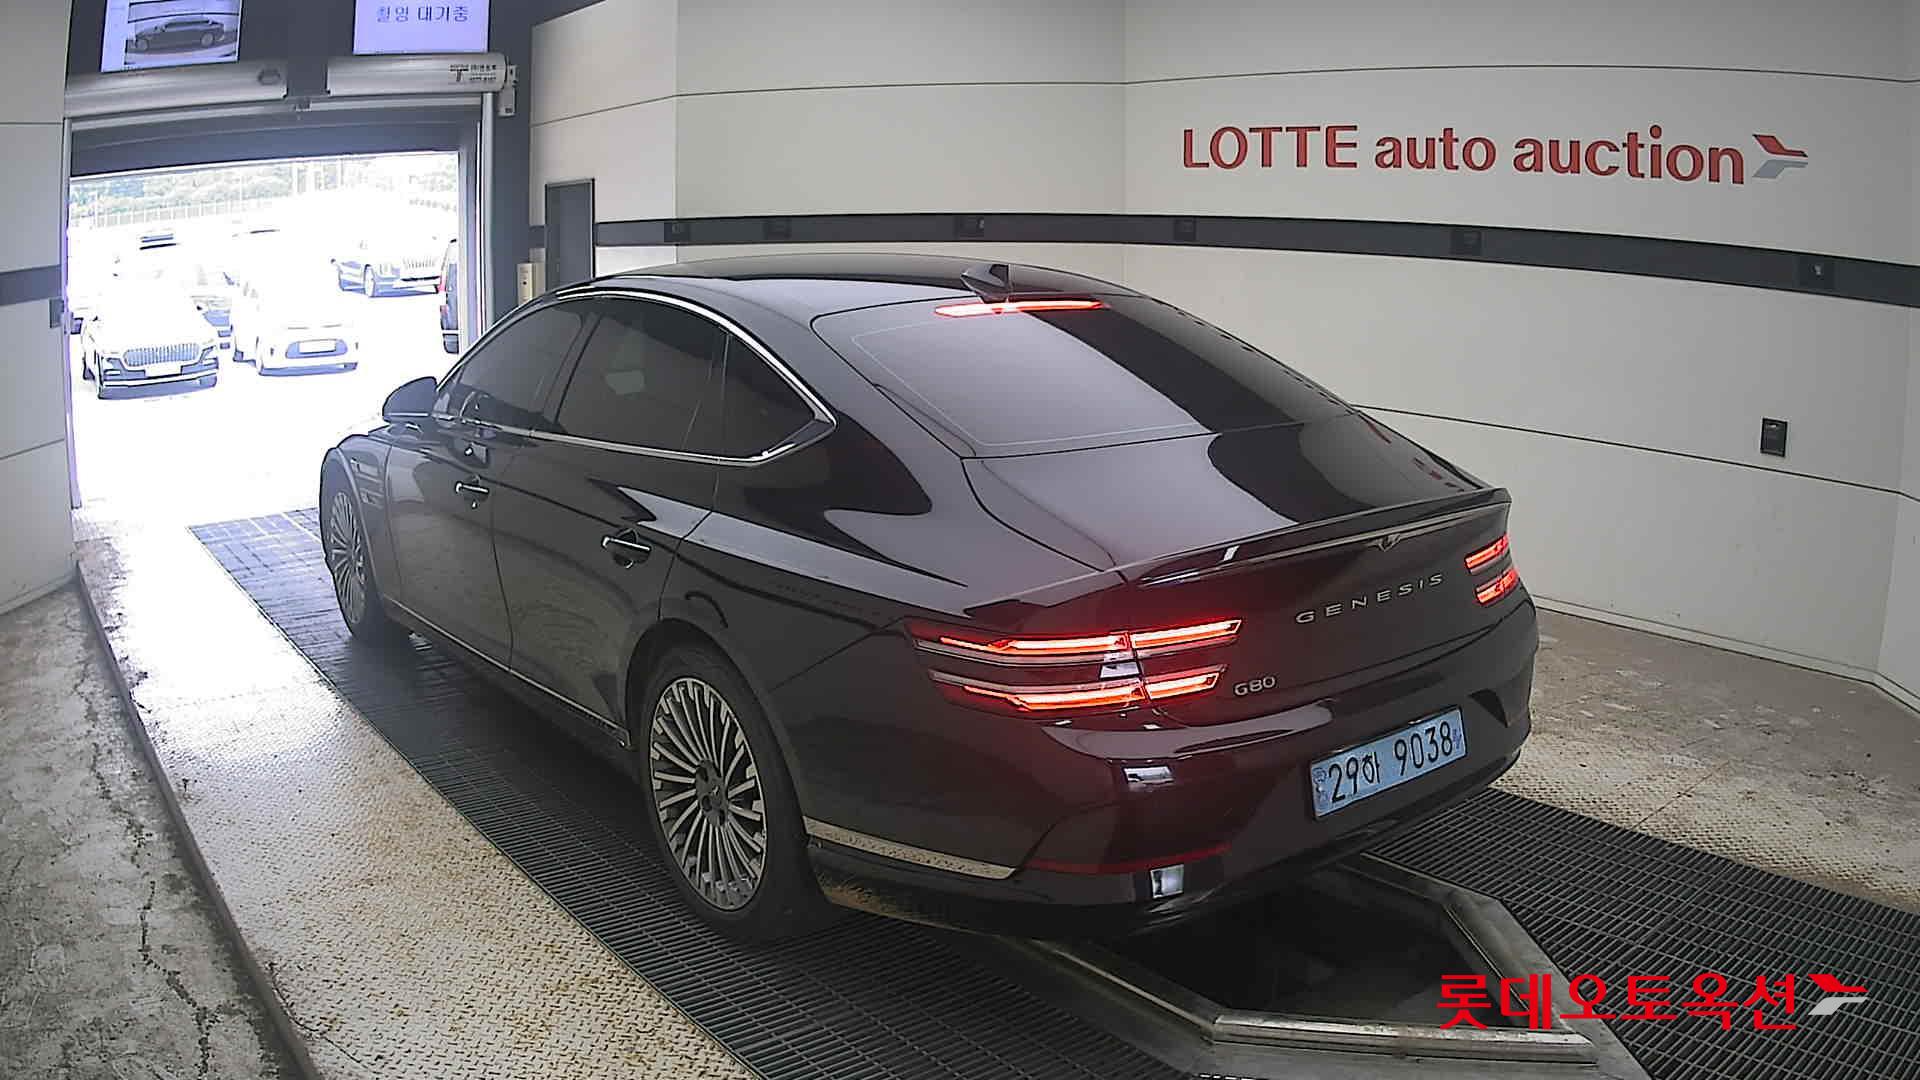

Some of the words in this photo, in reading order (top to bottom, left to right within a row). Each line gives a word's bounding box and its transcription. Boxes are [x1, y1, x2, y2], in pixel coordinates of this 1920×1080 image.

[417, 4, 469, 22] 대기중
[1183, 125, 1358, 169] LOTTE
[1375, 127, 1497, 172] auto
[1513, 124, 1745, 185] auction
[1296, 572, 1446, 624] GENESIS
[1234, 674, 1277, 697] G80
[1328, 751, 1381, 803] 29하
[1393, 721, 1453, 777] 9038
